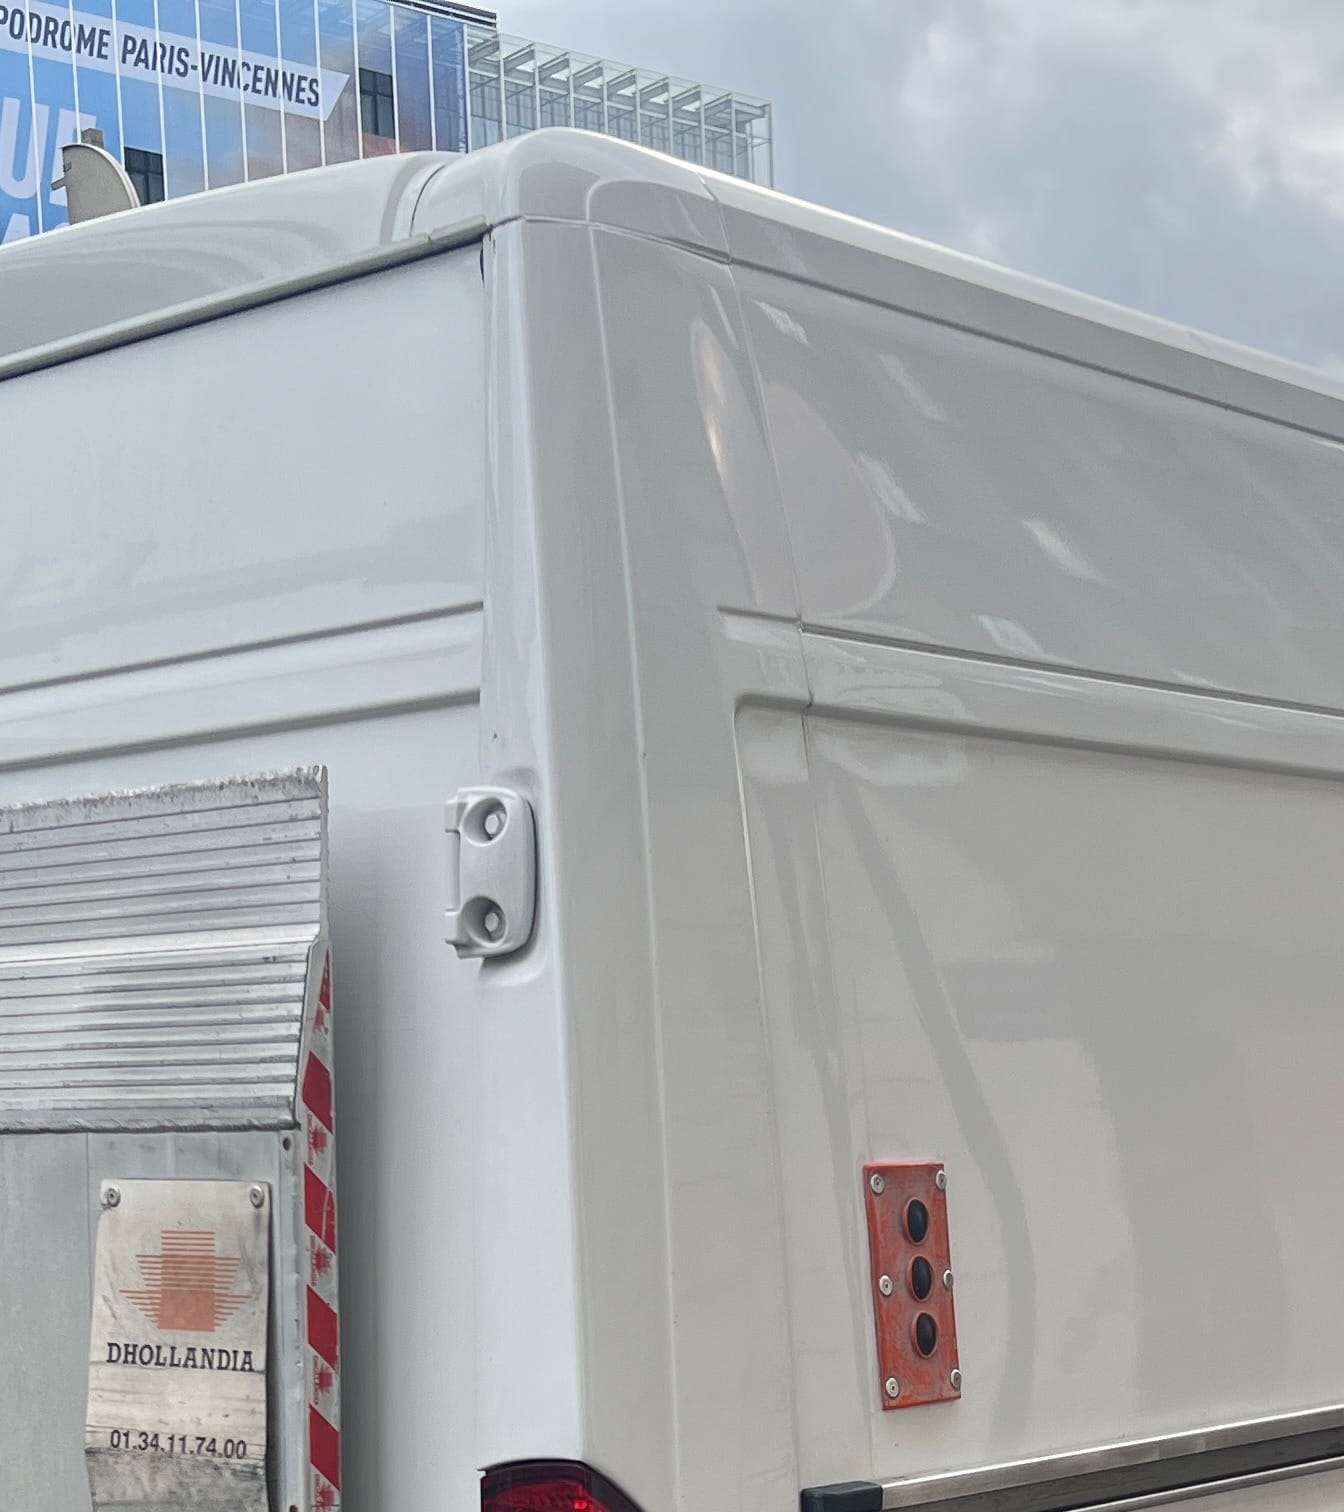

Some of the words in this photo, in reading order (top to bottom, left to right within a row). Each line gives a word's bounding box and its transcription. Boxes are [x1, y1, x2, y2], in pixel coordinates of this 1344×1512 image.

[122, 34, 320, 107] PARIS-VINCENNES
[106, 1342, 256, 1372] DHOLLANDIA
[110, 1429, 247, 1460] 01.34.11.74.00
